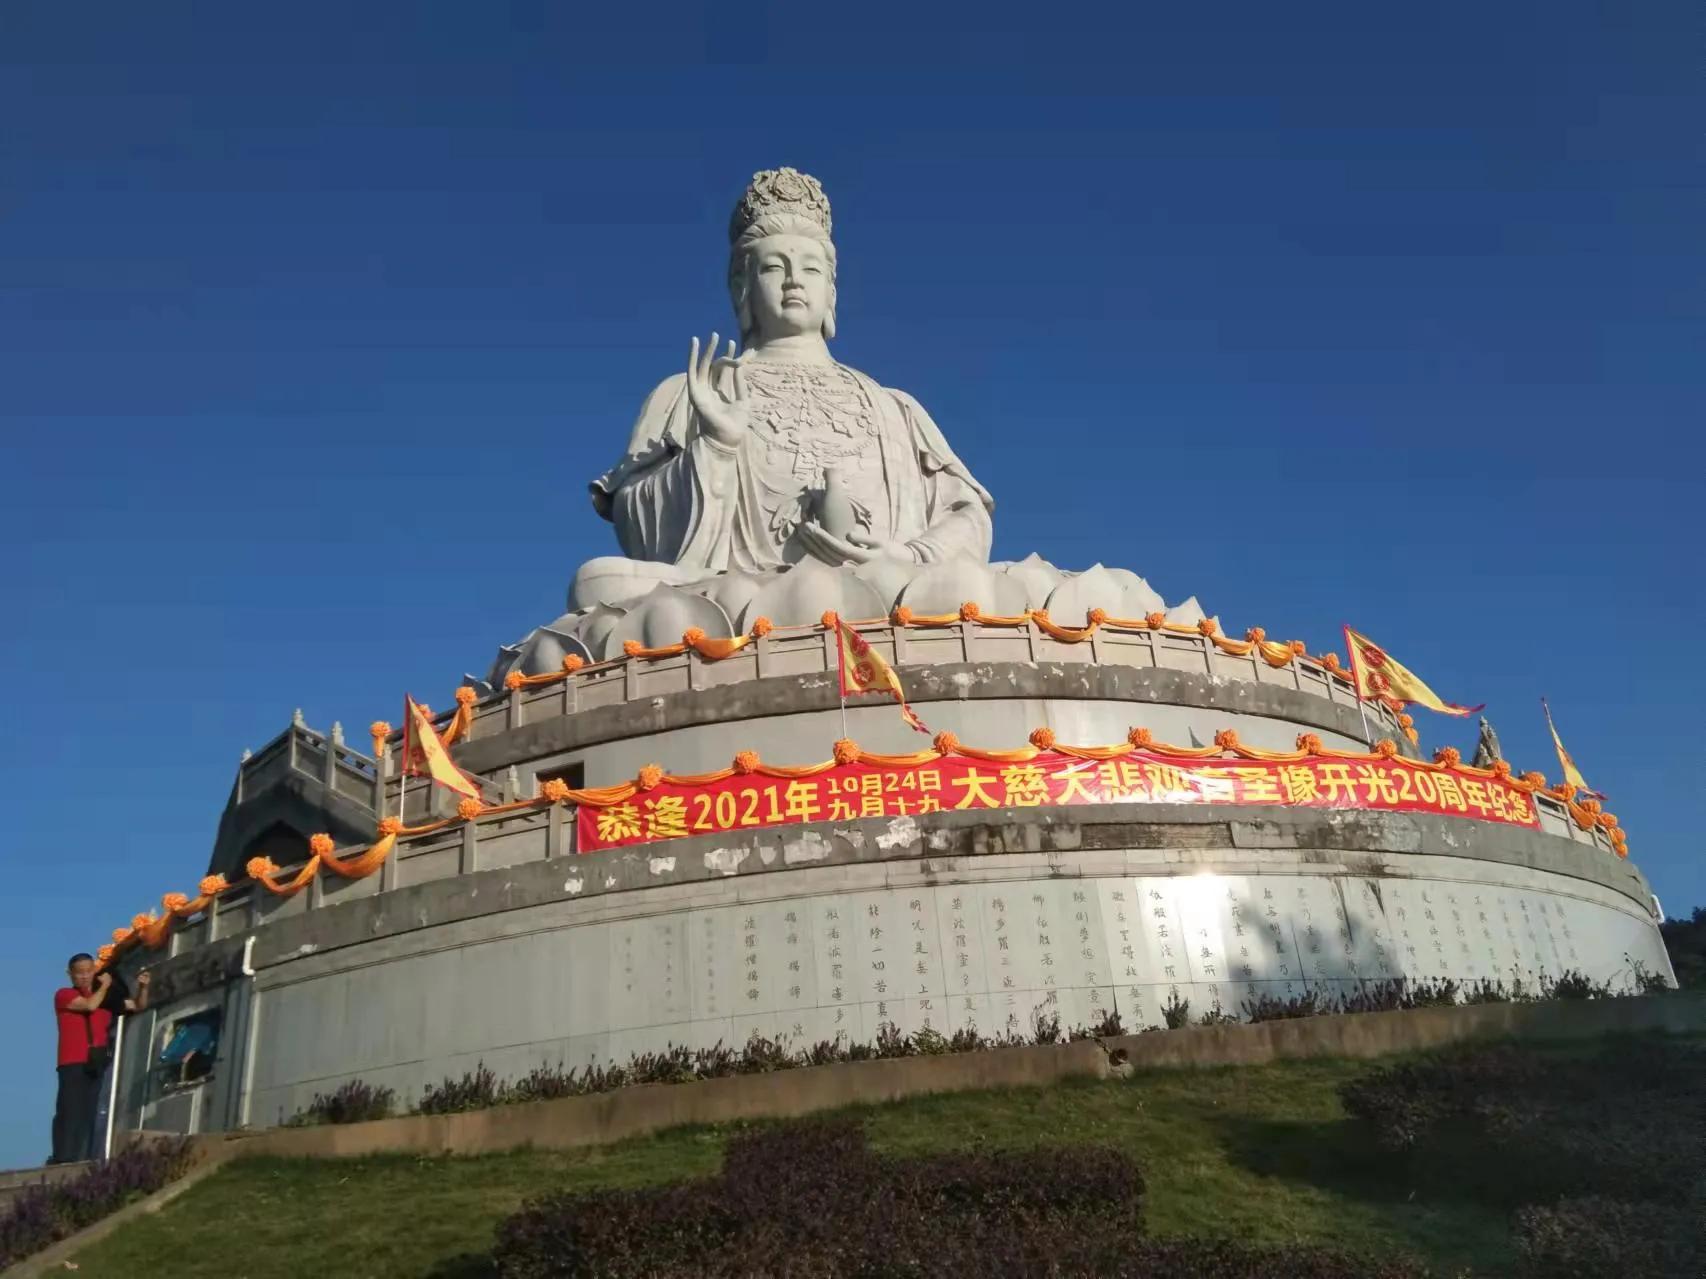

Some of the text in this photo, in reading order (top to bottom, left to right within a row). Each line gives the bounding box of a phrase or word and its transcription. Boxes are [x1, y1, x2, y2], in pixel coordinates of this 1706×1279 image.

[827, 769, 942, 795] 10月24日
[597, 781, 821, 841] 恭逢2021年
[827, 793, 944, 821] 九月十九
